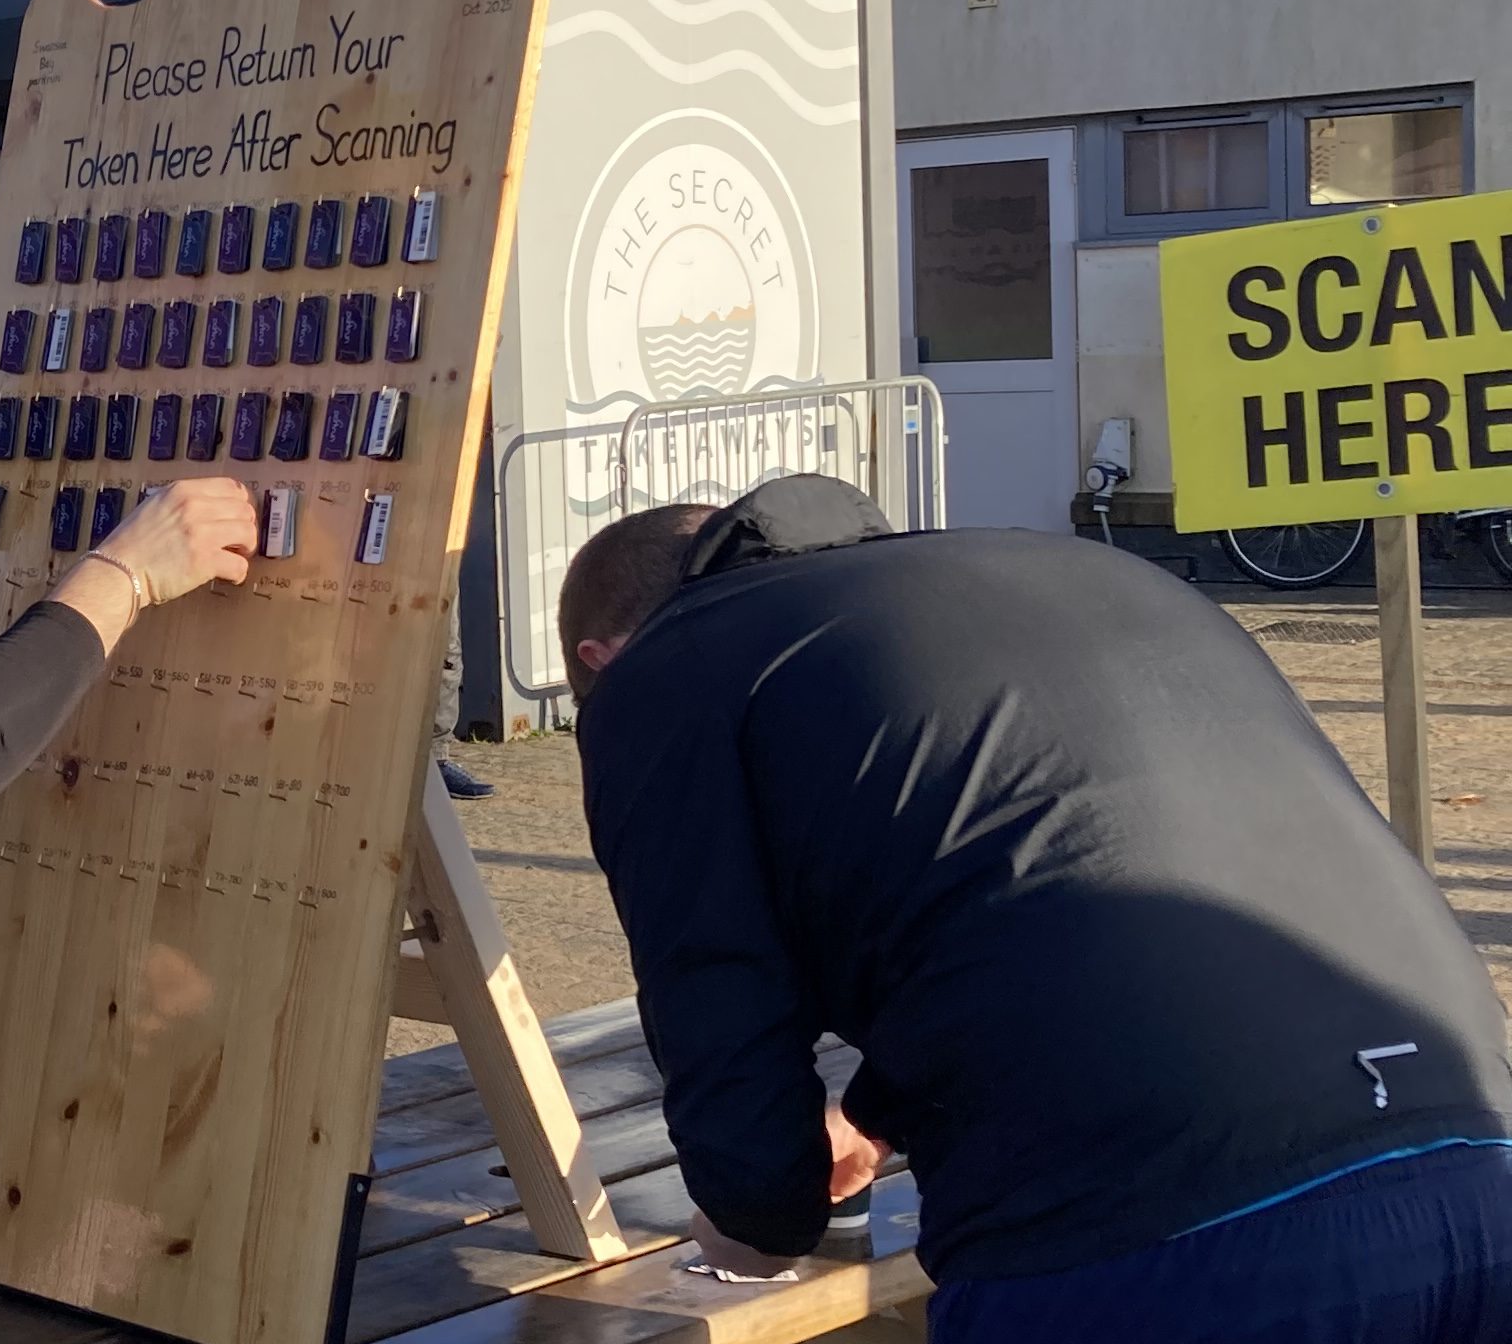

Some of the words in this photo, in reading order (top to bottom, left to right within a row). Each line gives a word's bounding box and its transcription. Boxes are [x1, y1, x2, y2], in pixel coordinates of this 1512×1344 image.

[101, 43, 206, 105] Please
[215, 27, 316, 90] Return
[329, 11, 405, 74] Your
[63, 137, 140, 190] Token
[148, 122, 213, 181] Here
[219, 109, 303, 176] After
[310, 103, 457, 174] Scanning
[605, 197, 657, 302] THE
[669, 169, 784, 289] SECRET
[1227, 235, 1512, 361] SCAN
[1243, 370, 1512, 488] HERE
